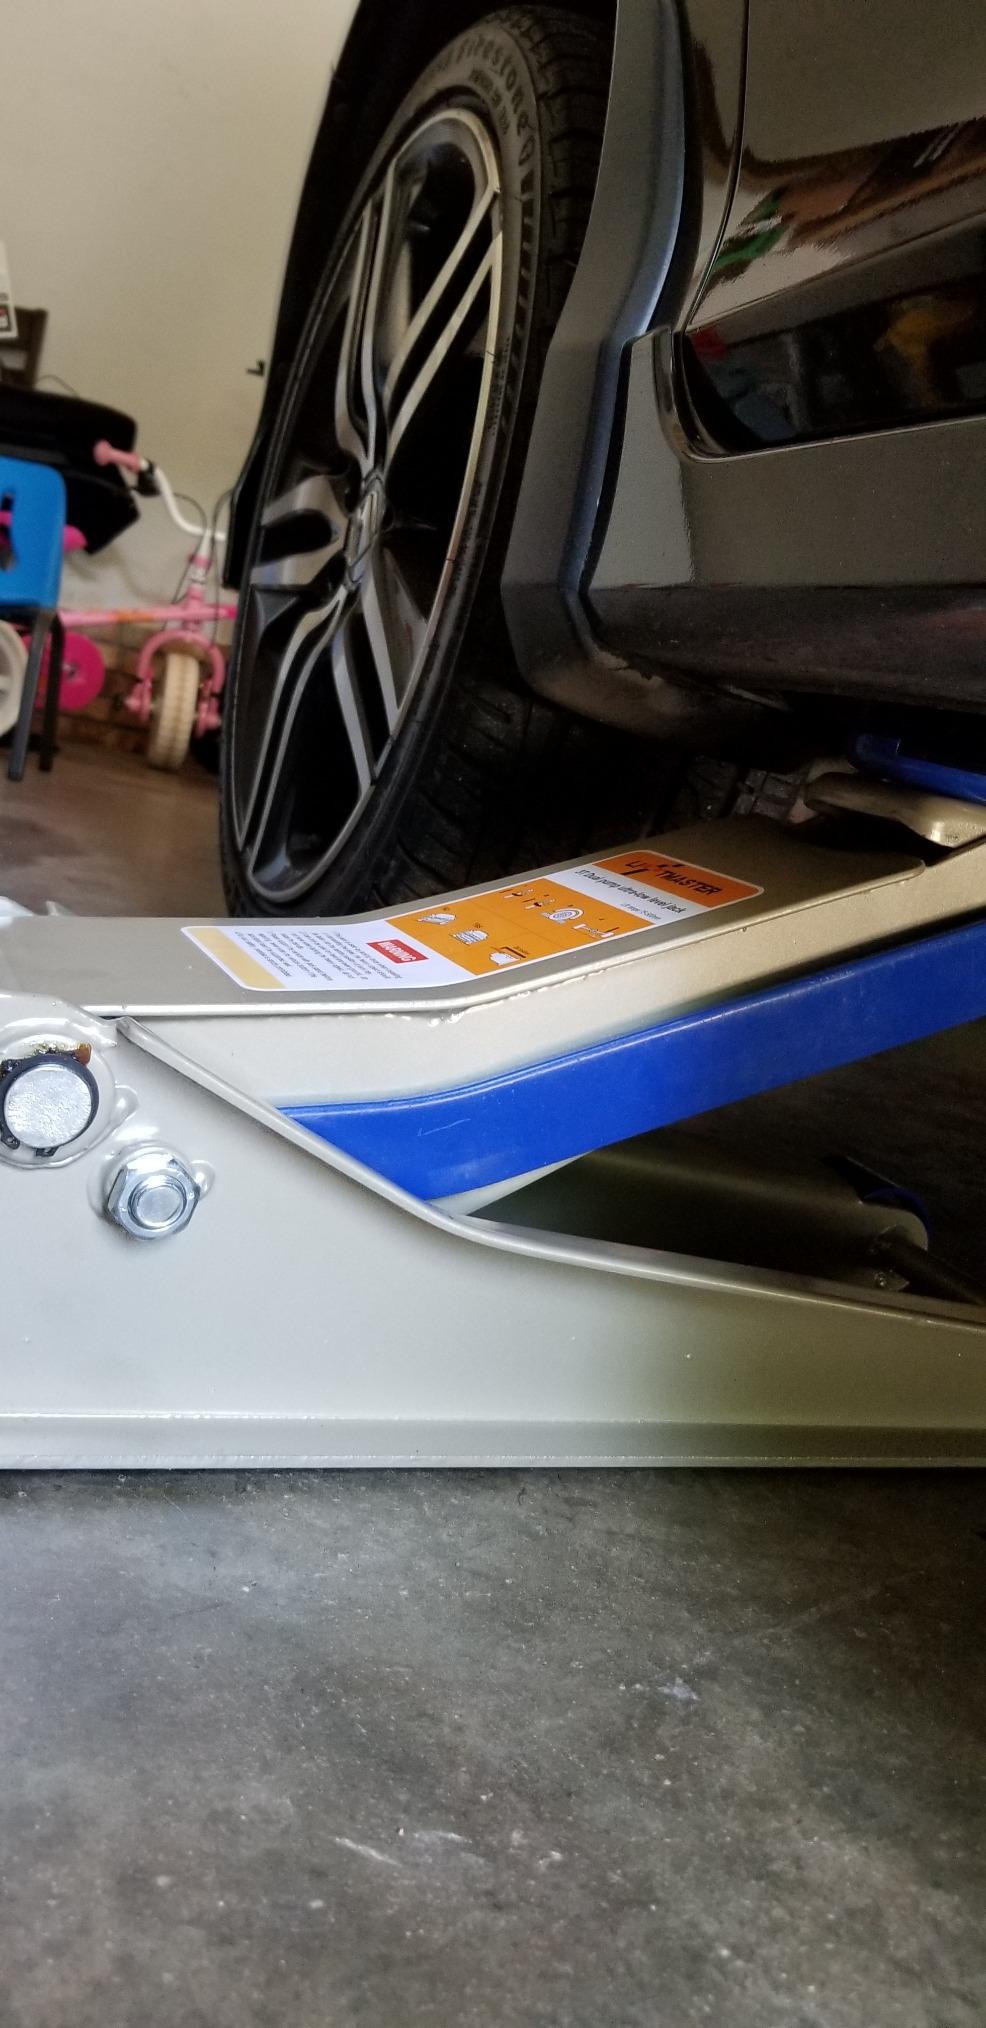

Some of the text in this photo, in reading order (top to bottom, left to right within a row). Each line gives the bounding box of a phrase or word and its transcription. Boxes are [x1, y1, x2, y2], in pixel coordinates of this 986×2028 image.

[582, 871, 604, 880] Dual
[595, 878, 621, 888] pump
[377, 942, 417, 961] WARNING
